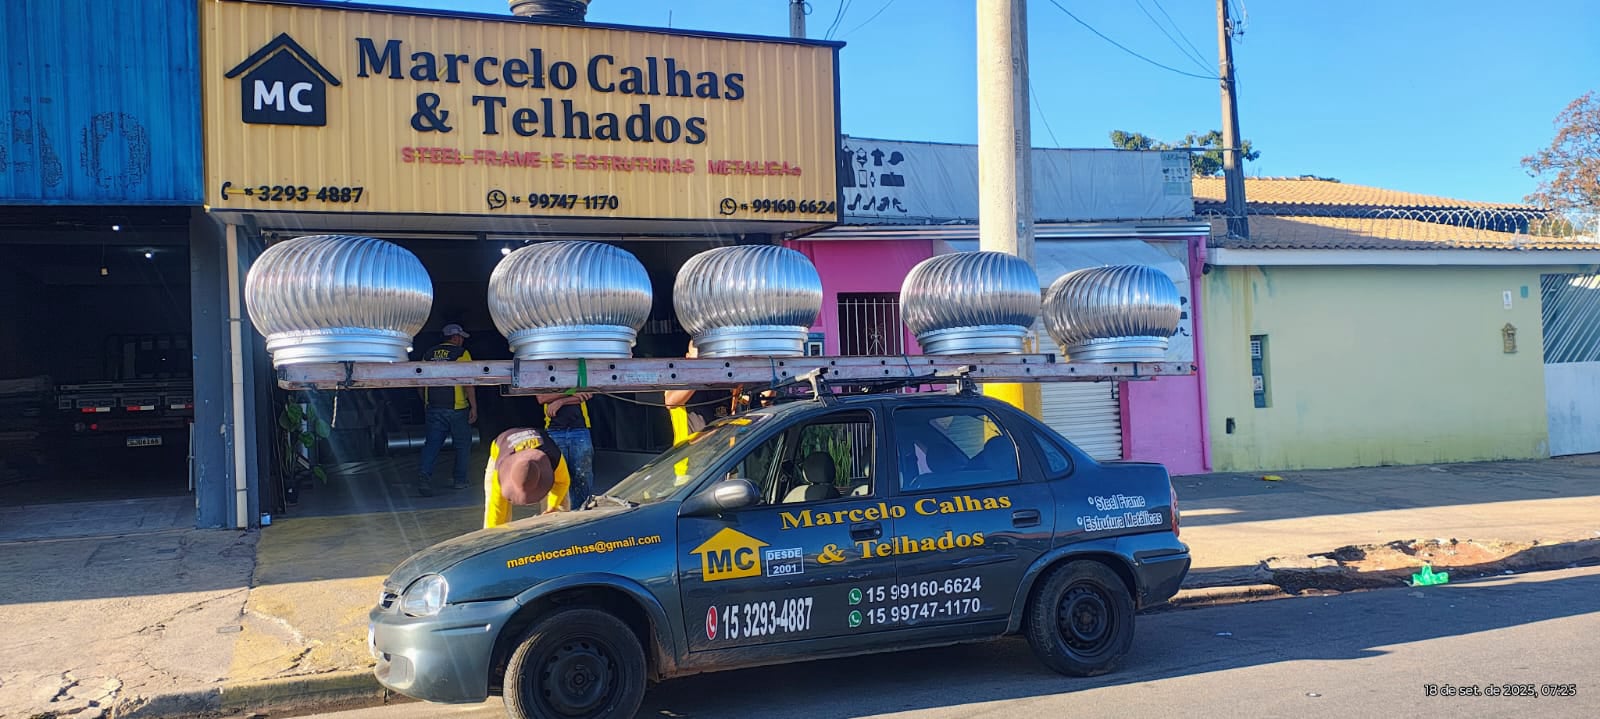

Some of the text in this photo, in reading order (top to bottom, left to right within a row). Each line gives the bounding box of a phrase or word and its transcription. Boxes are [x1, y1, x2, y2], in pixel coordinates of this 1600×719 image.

[356, 37, 744, 100] Marcelo Calhas
[253, 79, 313, 113] MC
[410, 92, 706, 145] & Telhados
[402, 147, 464, 165] STEEL
[473, 149, 541, 168] FRAME
[552, 153, 564, 169] E
[575, 154, 695, 174] ESTRUTURAS
[258, 185, 309, 202] 3293
[316, 186, 364, 203] 4887
[528, 193, 578, 209] 99747
[582, 195, 619, 210] 1170
[752, 198, 796, 214] 99160
[799, 199, 836, 215] 6624
[780, 494, 1013, 530] Marcelo Calhas
[1094, 494, 1146, 511] Steel Frame
[1083, 514, 1125, 532] Estrutura
[506, 533, 661, 569] marceloccalhas@gmail.com
[706, 546, 755, 575] MC
[767, 549, 801, 561] DESDE
[816, 530, 985, 565] & Telhados
[772, 564, 797, 575] 2001
[866, 576, 982, 603] 15 99160-6624
[722, 597, 813, 640] 15 3293-4887
[866, 598, 981, 625] 15 99747-1170
